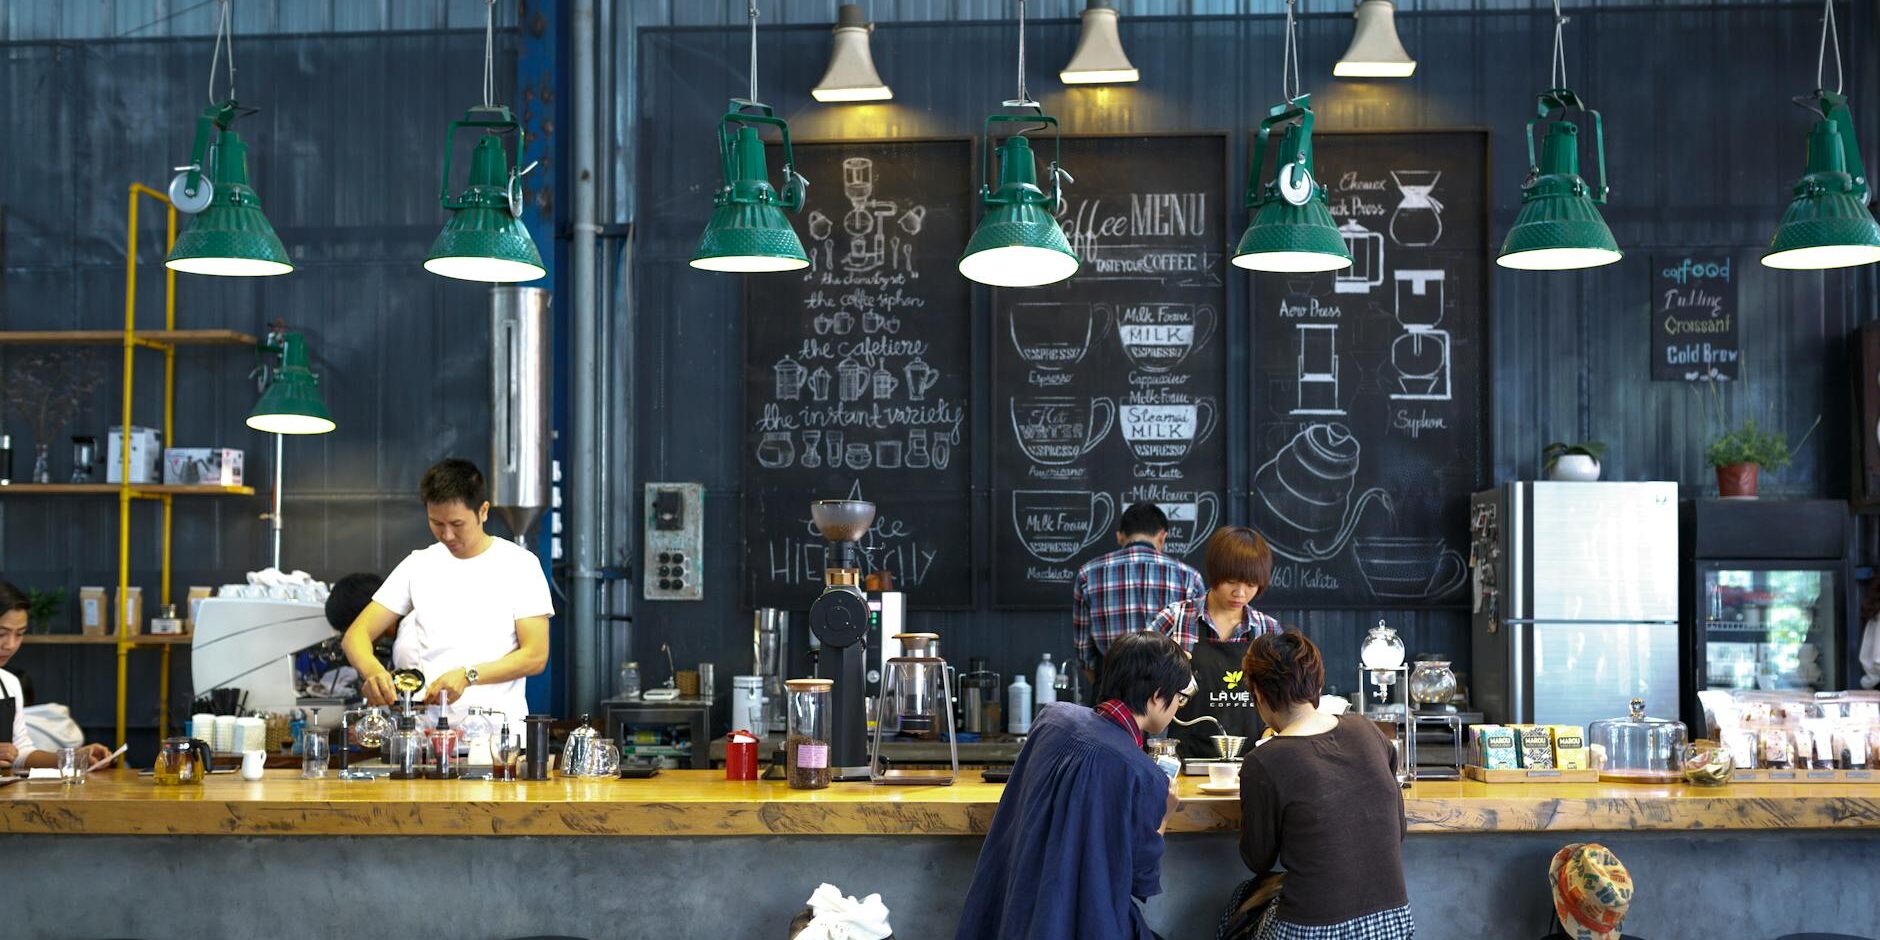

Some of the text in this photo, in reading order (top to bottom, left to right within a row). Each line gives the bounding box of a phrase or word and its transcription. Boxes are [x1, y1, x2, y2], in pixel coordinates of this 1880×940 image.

[1131, 193, 1206, 236] MENU
[1352, 196, 1386, 216] Press
[1096, 259, 1120, 272] TASTE
[1143, 254, 1197, 272] COFFEE
[821, 271, 840, 284] the
[804, 290, 835, 309] the
[839, 288, 875, 311] coffee
[1124, 306, 1154, 322] Milk
[1130, 328, 1184, 342] MILK
[1665, 315, 1729, 335] Croissant
[799, 338, 835, 359] the
[1022, 348, 1081, 361] ESPRESSO
[1667, 342, 1738, 364] Cold Brew
[757, 398, 964, 445] the instant variety
[1019, 423, 1084, 440] WATER
[1131, 423, 1182, 438] MILK
[1393, 409, 1448, 438] Syphon
[1132, 484, 1160, 501] Milk
[1025, 512, 1088, 532] Milk Foam
[769, 537, 937, 587] HIERCHY
[1301, 567, 1340, 589] Kalita
[1230, 690, 1250, 703] VIỆ
